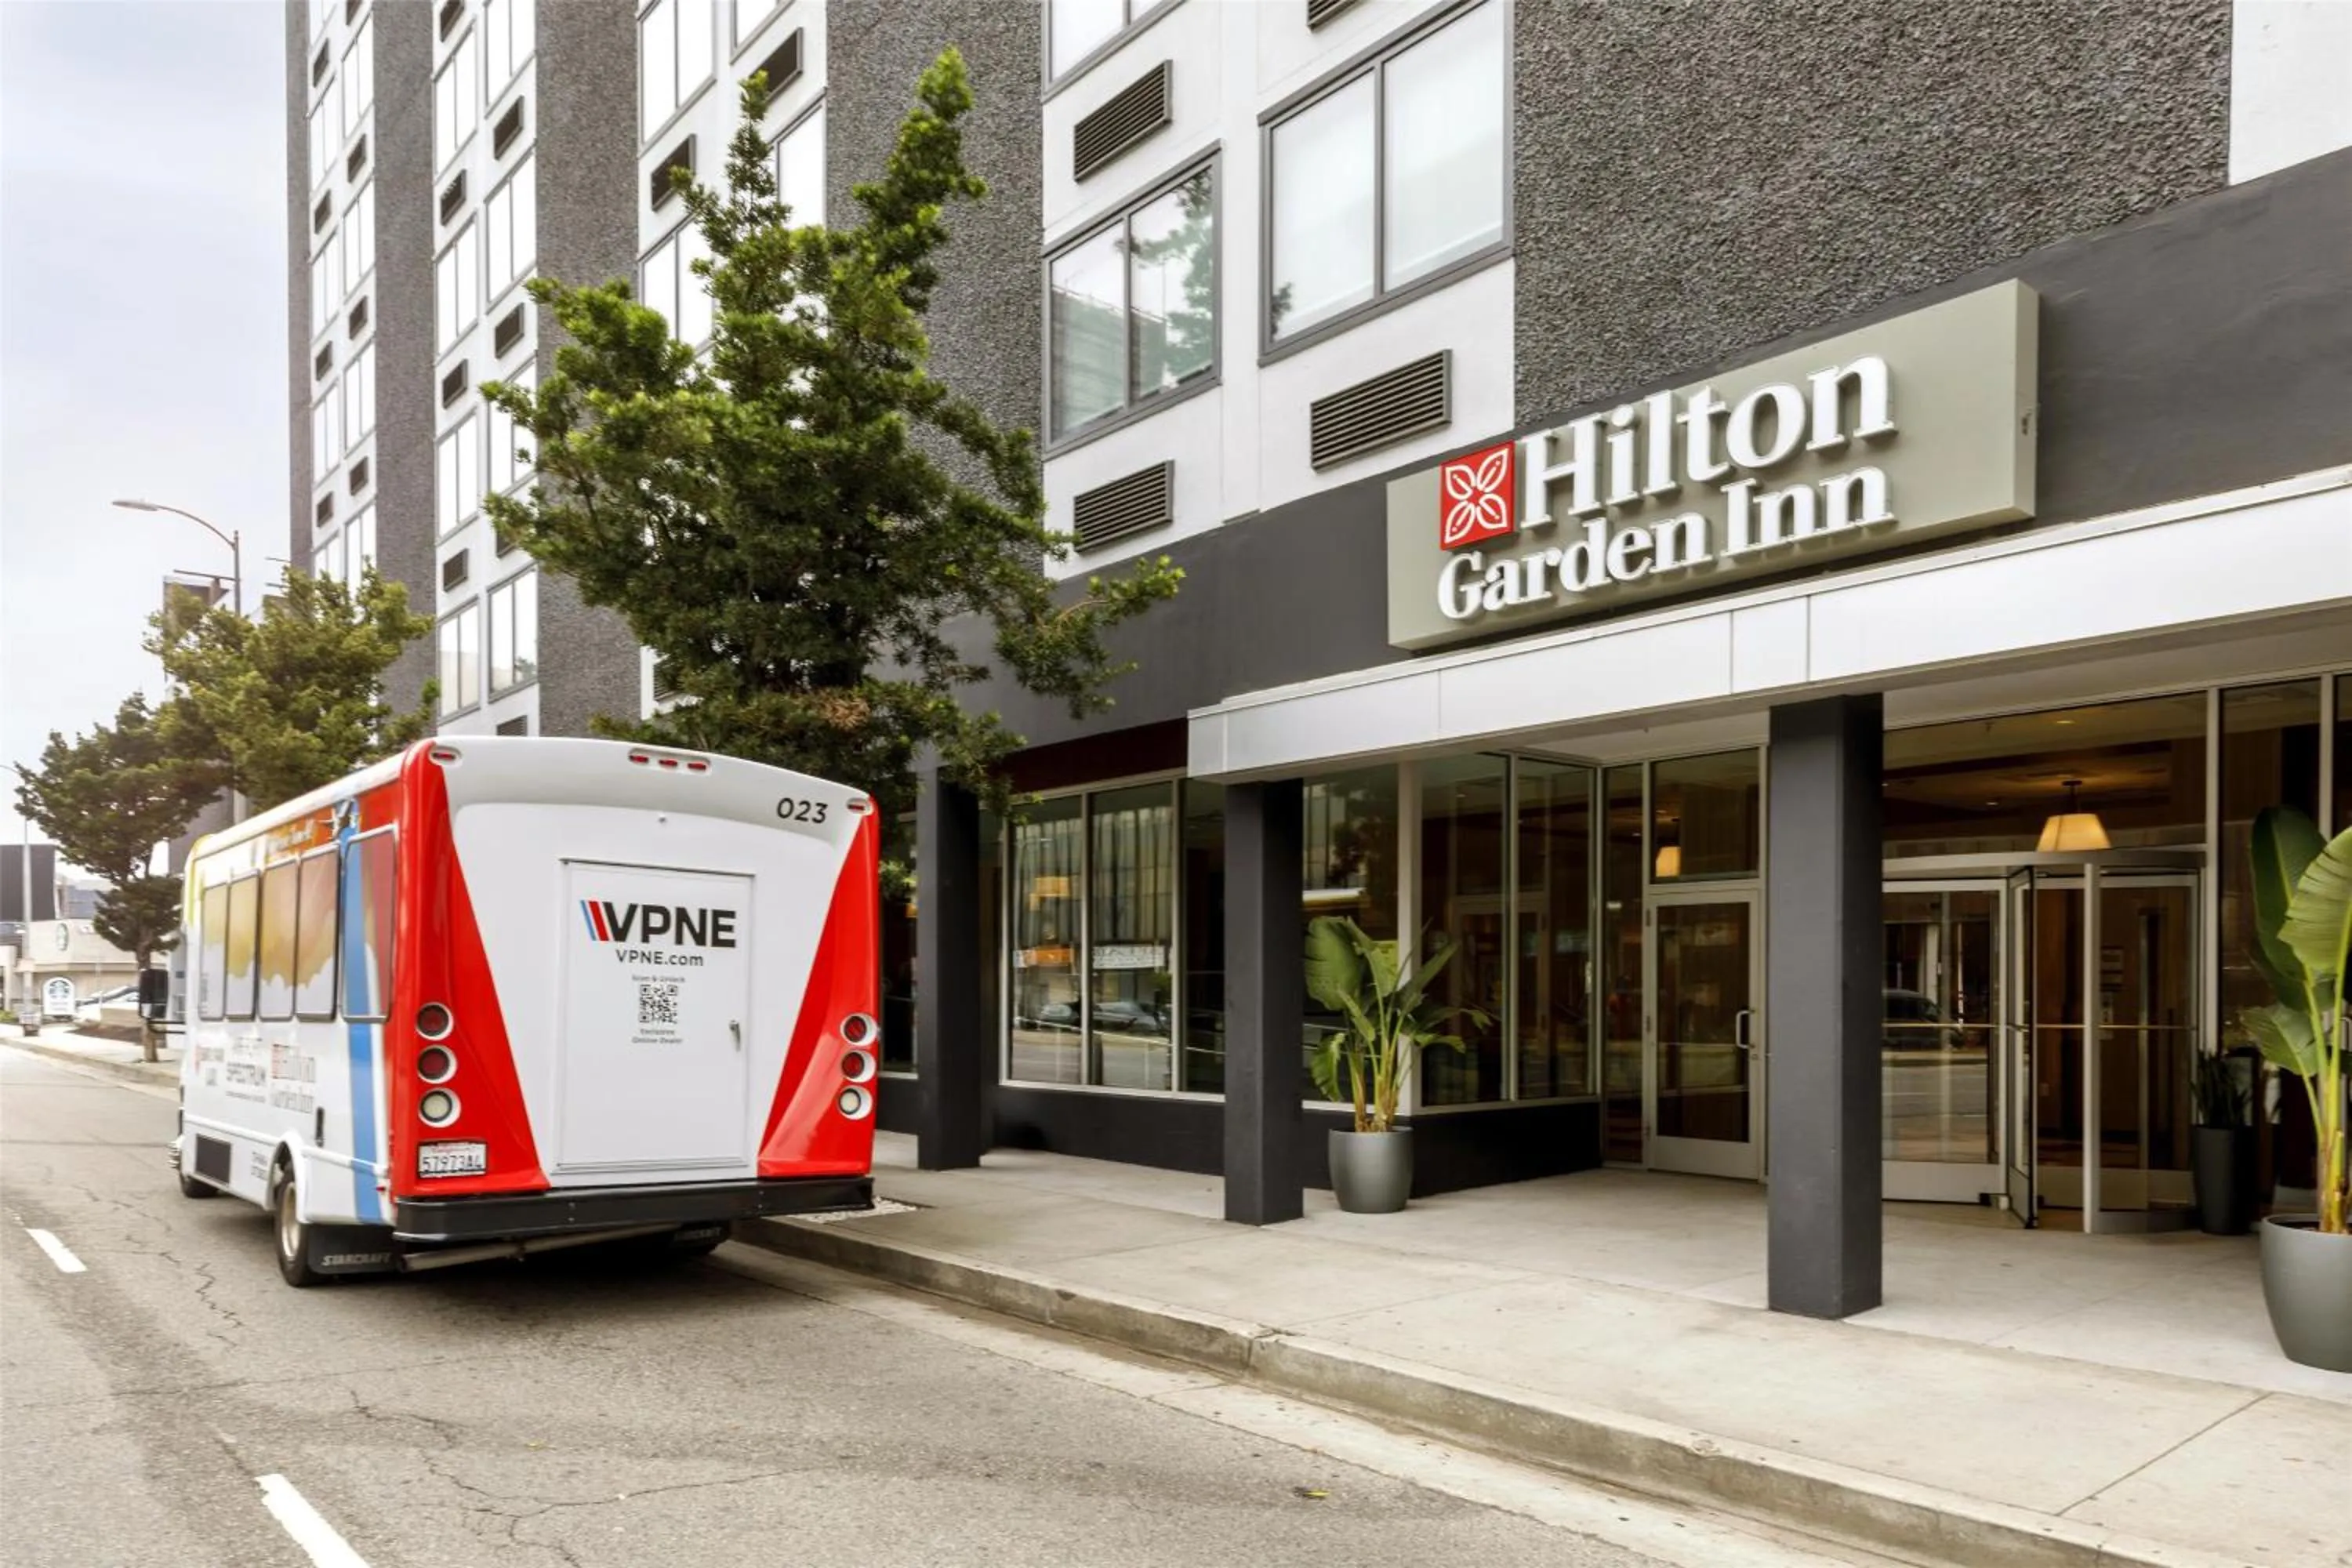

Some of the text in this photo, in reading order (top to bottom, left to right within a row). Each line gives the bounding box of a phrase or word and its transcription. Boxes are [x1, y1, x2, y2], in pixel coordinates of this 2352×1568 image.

[1519, 354, 1896, 529] Hilton
[1437, 464, 1895, 620] Garden Inn
[777, 797, 828, 824] 023
[603, 902, 736, 948] VPNE
[615, 949, 704, 967] VPNE.com
